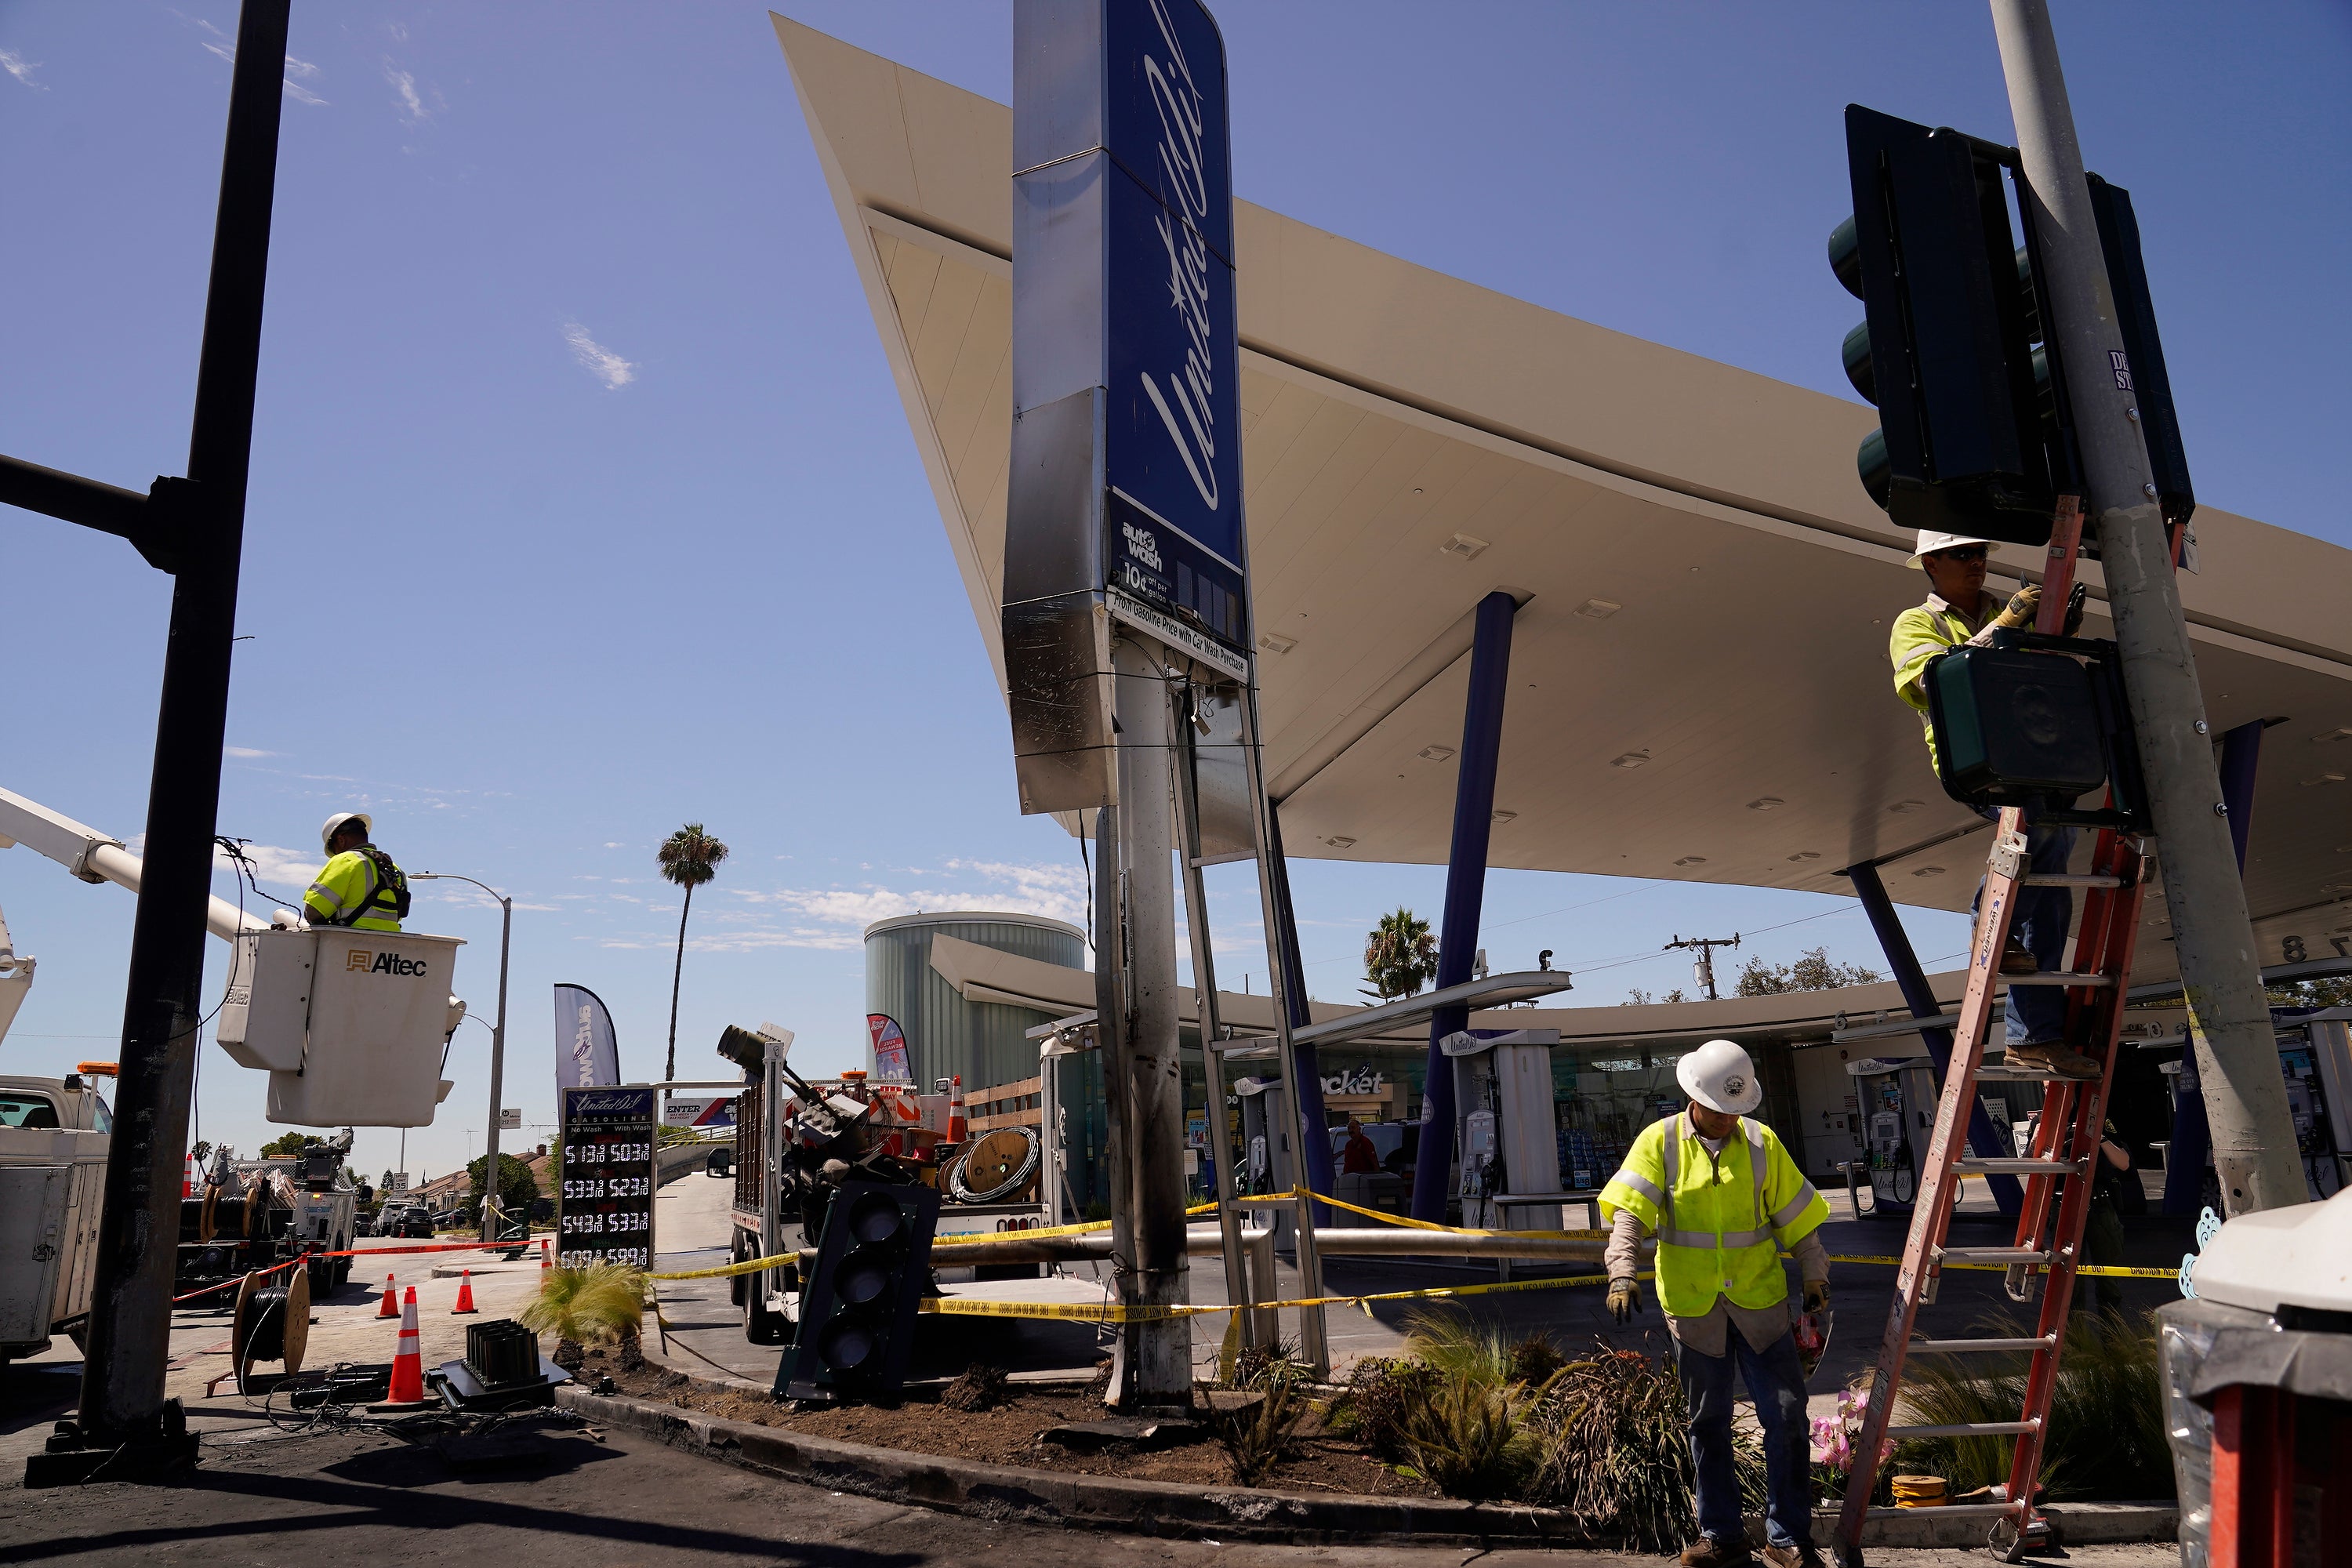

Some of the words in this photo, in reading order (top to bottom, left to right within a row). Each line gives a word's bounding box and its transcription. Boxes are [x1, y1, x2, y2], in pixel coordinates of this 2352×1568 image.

[1144, 0, 1207, 217] Oil
[1142, 141, 1218, 511] United
[1122, 521, 1156, 552] auto
[1127, 539, 1163, 572] wash
[1124, 561, 1147, 593] 10¢
[1148, 576, 1157, 586] off
[1158, 582, 1167, 593] per
[1148, 588, 1167, 604] gallon
[1114, 594, 1131, 612] From
[1134, 602, 1161, 628] Gasoline
[1162, 617, 1178, 637] Price
[1178, 627, 1192, 644] with
[1192, 632, 1203, 651] Car
[1204, 641, 1220, 659] Wash
[1220, 646, 1244, 673] Purchase
[1984, 909, 1998, 954] WERNER
[2282, 935, 2307, 964] 8
[371, 953, 427, 977] Altec
[1835, 1010, 1846, 1030] 6
[1857, 1061, 1875, 1073] United
[577, 1094, 614, 1112] United
[614, 1094, 643, 1111] Oil
[666, 1105, 701, 1113] ENTER
[572, 1115, 647, 1123] GASOLINE
[927, 1300, 936, 1310] FIRE
[943, 1301, 957, 1311] CROSS
[956, 1301, 965, 1312] NOT
[964, 1301, 971, 1312] DO
[971, 1302, 981, 1312] LINE
[981, 1303, 990, 1312] FIRE
[998, 1303, 1012, 1314] CROSS
[1013, 1304, 1022, 1314] NOT
[1022, 1304, 1029, 1315] DO
[1029, 1305, 1039, 1315] LINE
[1039, 1305, 1049, 1316] FIRE
[1058, 1305, 1074, 1317] CROSS
[1075, 1306, 1084, 1317] NOT
[1085, 1306, 1092, 1318] DO
[1092, 1306, 1103, 1318] LINE
[1103, 1307, 1115, 1319] FIRE
[1126, 1307, 1147, 1319] CROSS
[1149, 1307, 1162, 1318] NOT
[1163, 1307, 1173, 1316] DO
